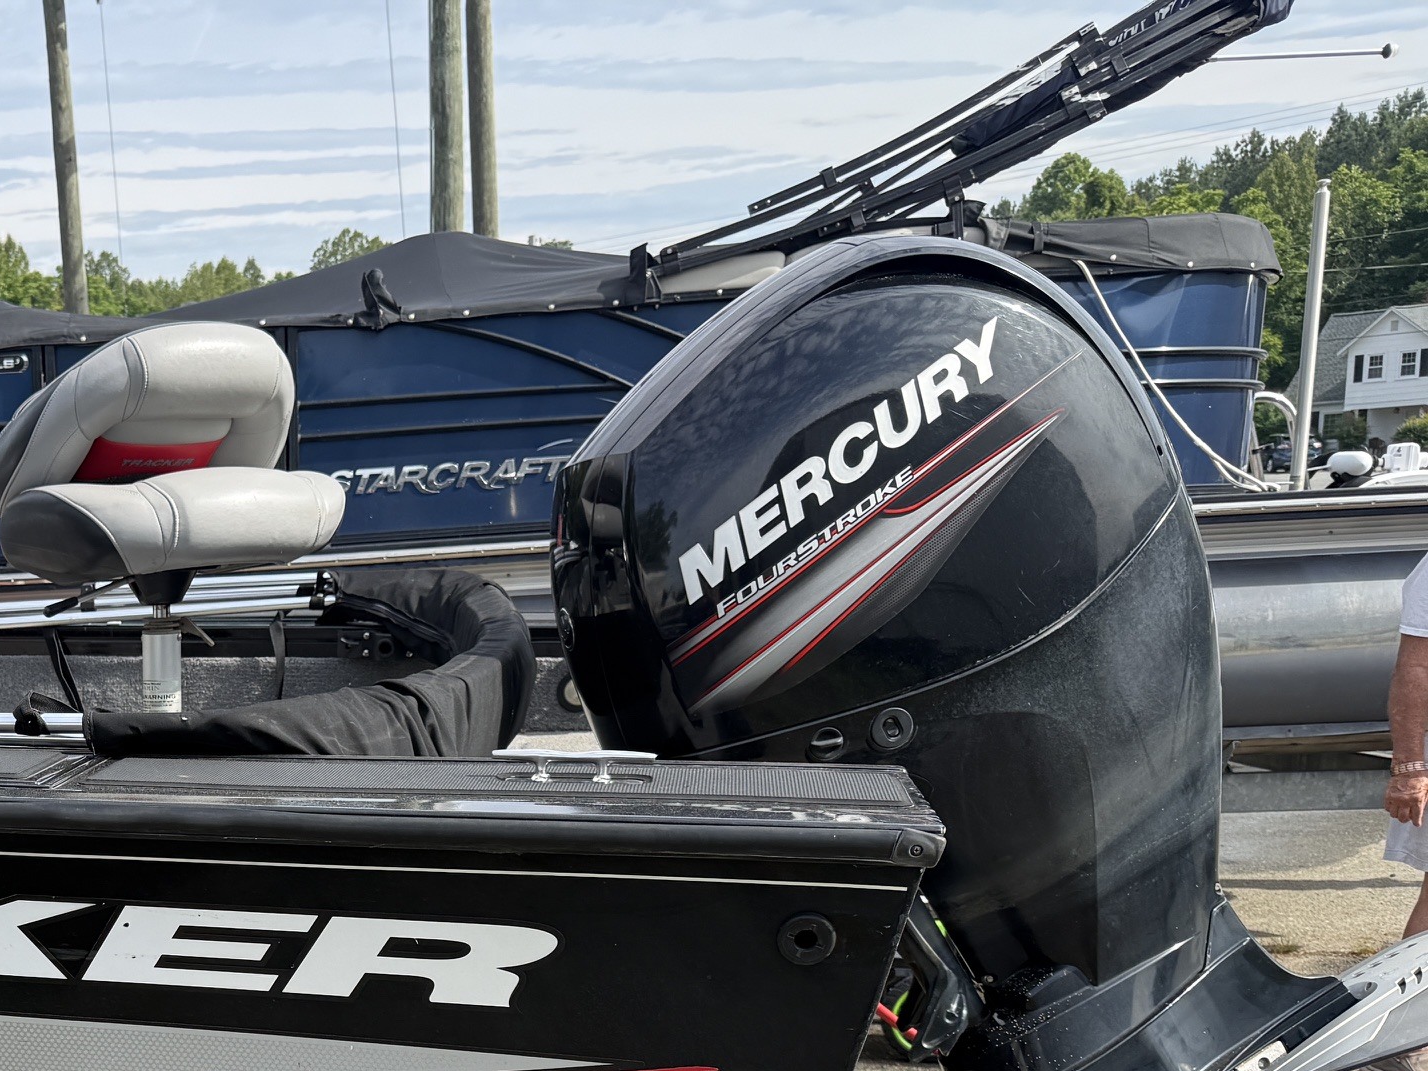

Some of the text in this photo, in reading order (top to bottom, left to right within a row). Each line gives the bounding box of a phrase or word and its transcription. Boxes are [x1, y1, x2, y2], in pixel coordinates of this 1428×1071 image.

[330, 454, 573, 495] STARCRAFT
[678, 315, 998, 606] MERCURY
[716, 463, 916, 619] FOURSTROKE
